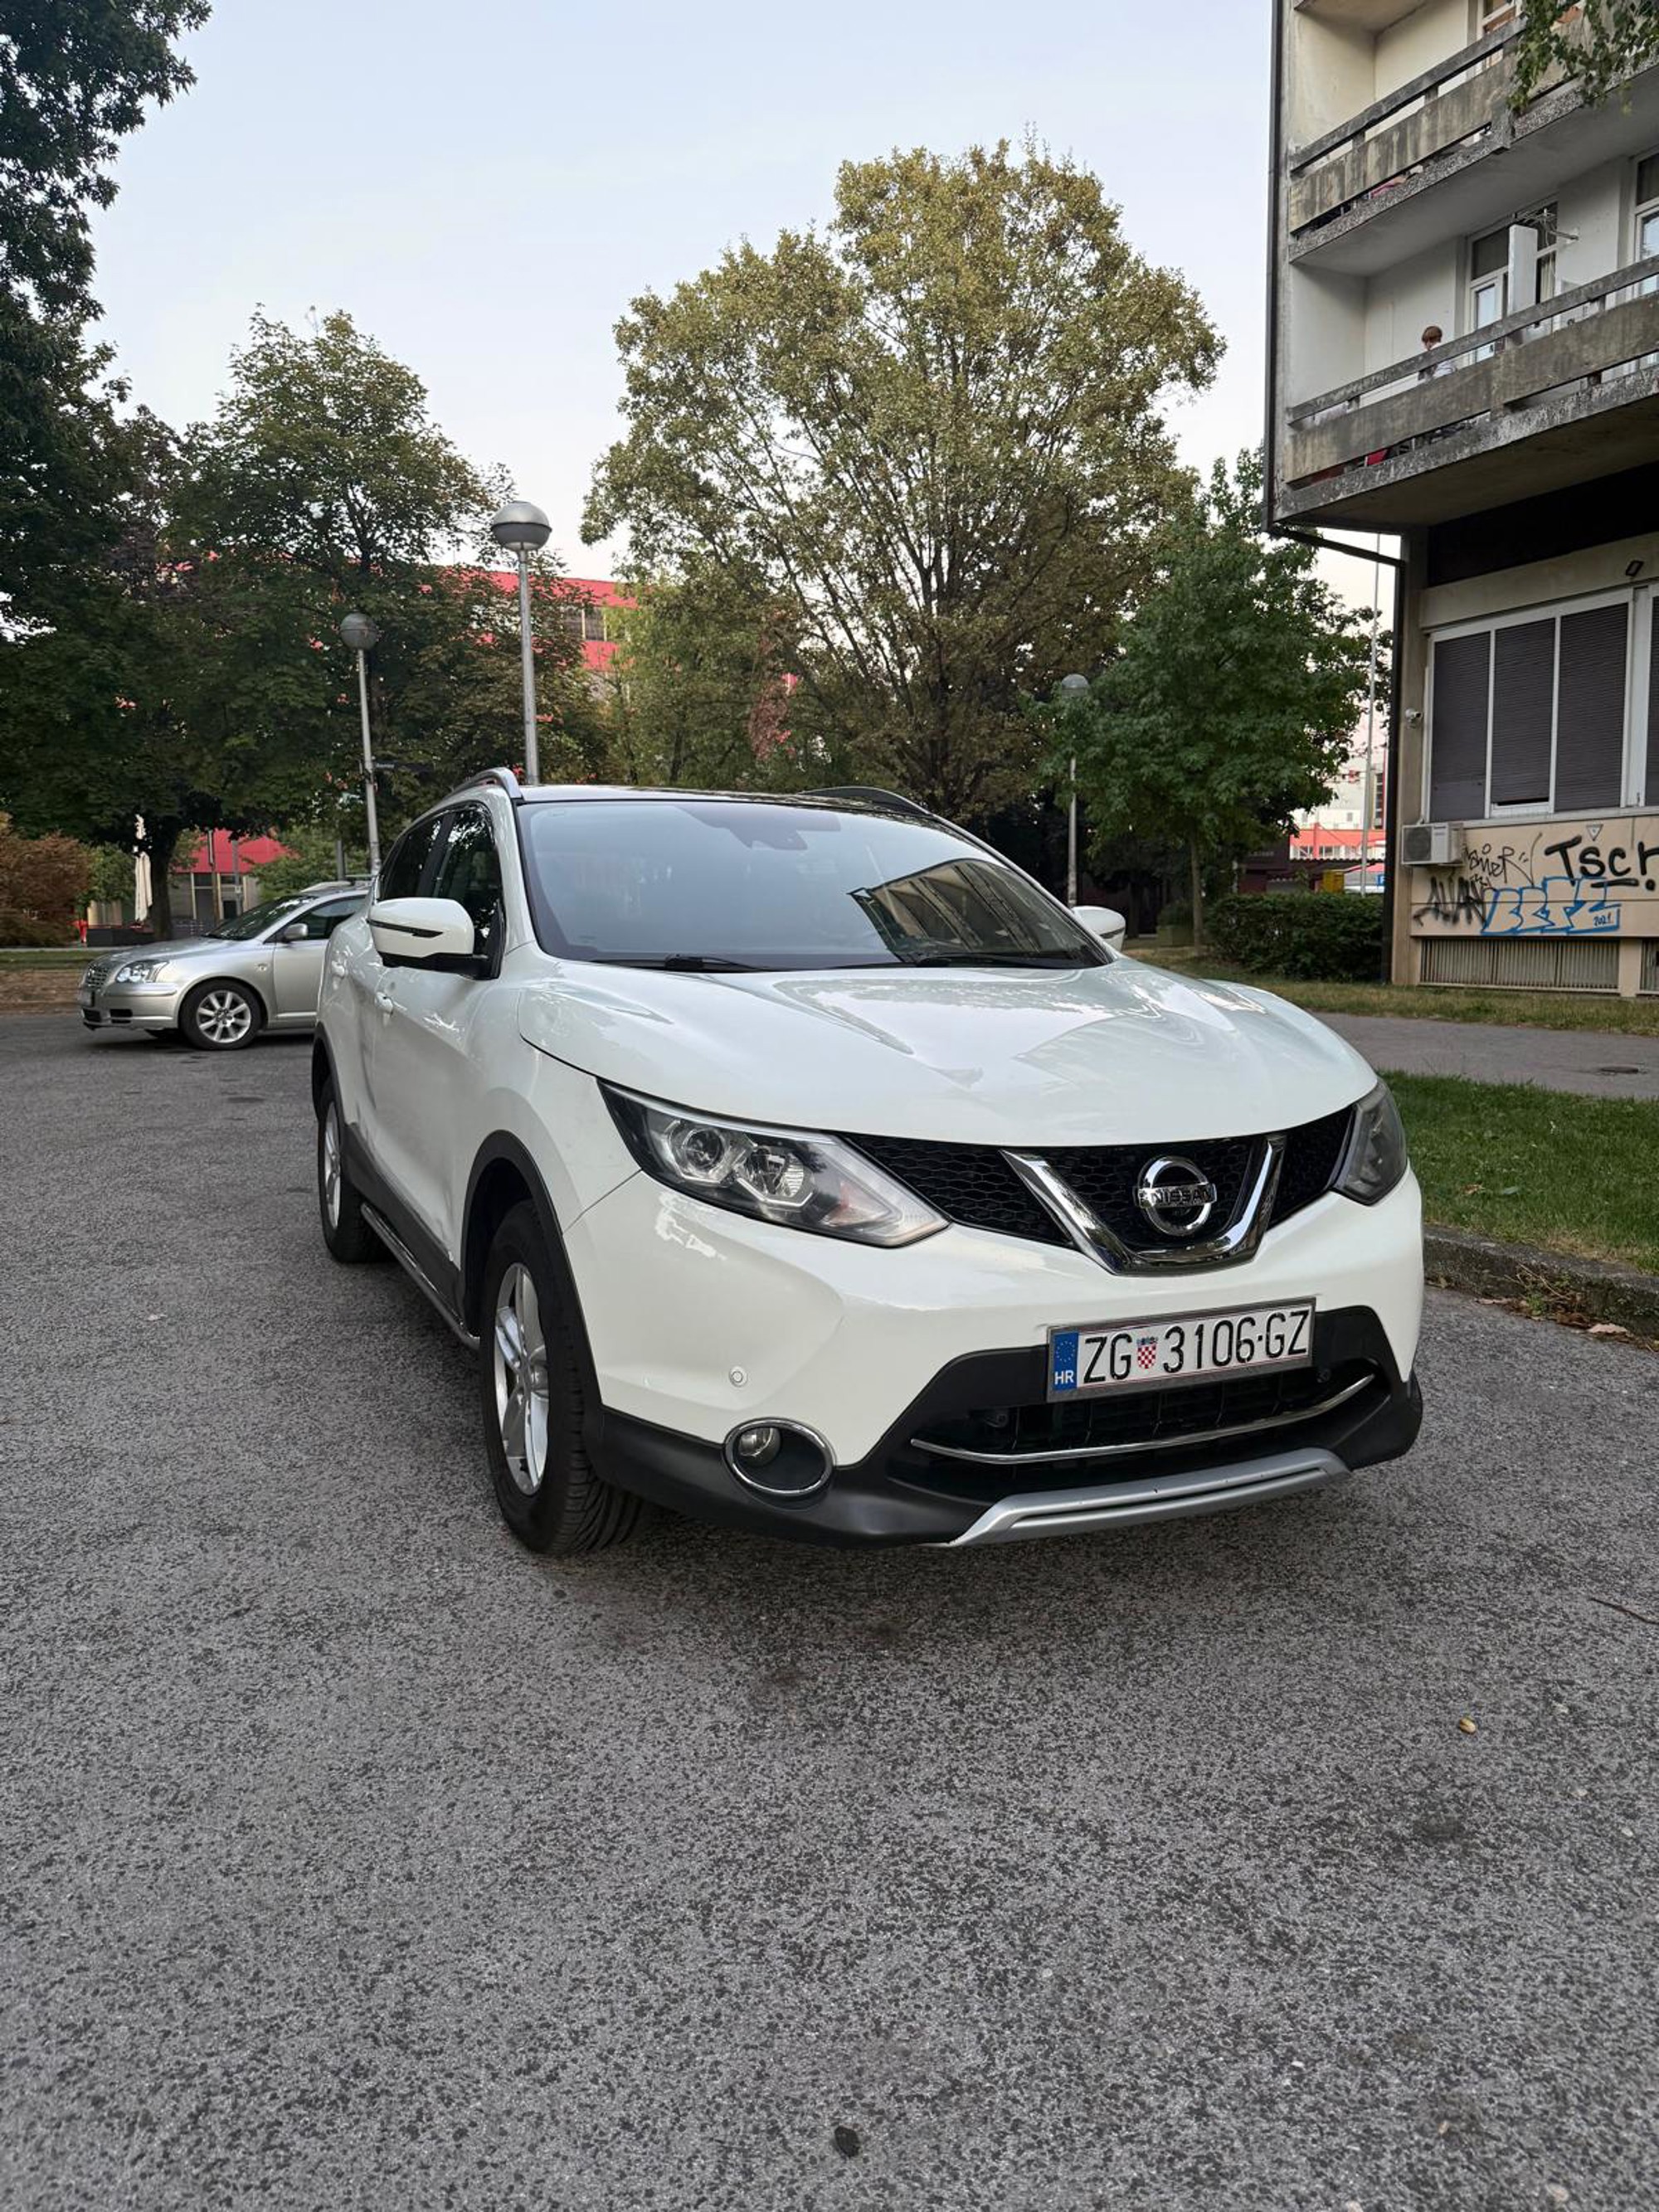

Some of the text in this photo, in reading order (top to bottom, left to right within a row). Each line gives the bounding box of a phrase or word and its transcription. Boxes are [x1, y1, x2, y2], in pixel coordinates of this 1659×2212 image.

[1151, 1185, 1209, 1205] NISSAN
[1083, 1333, 1132, 1383] ZG
[1054, 1369, 1074, 1385] HR
